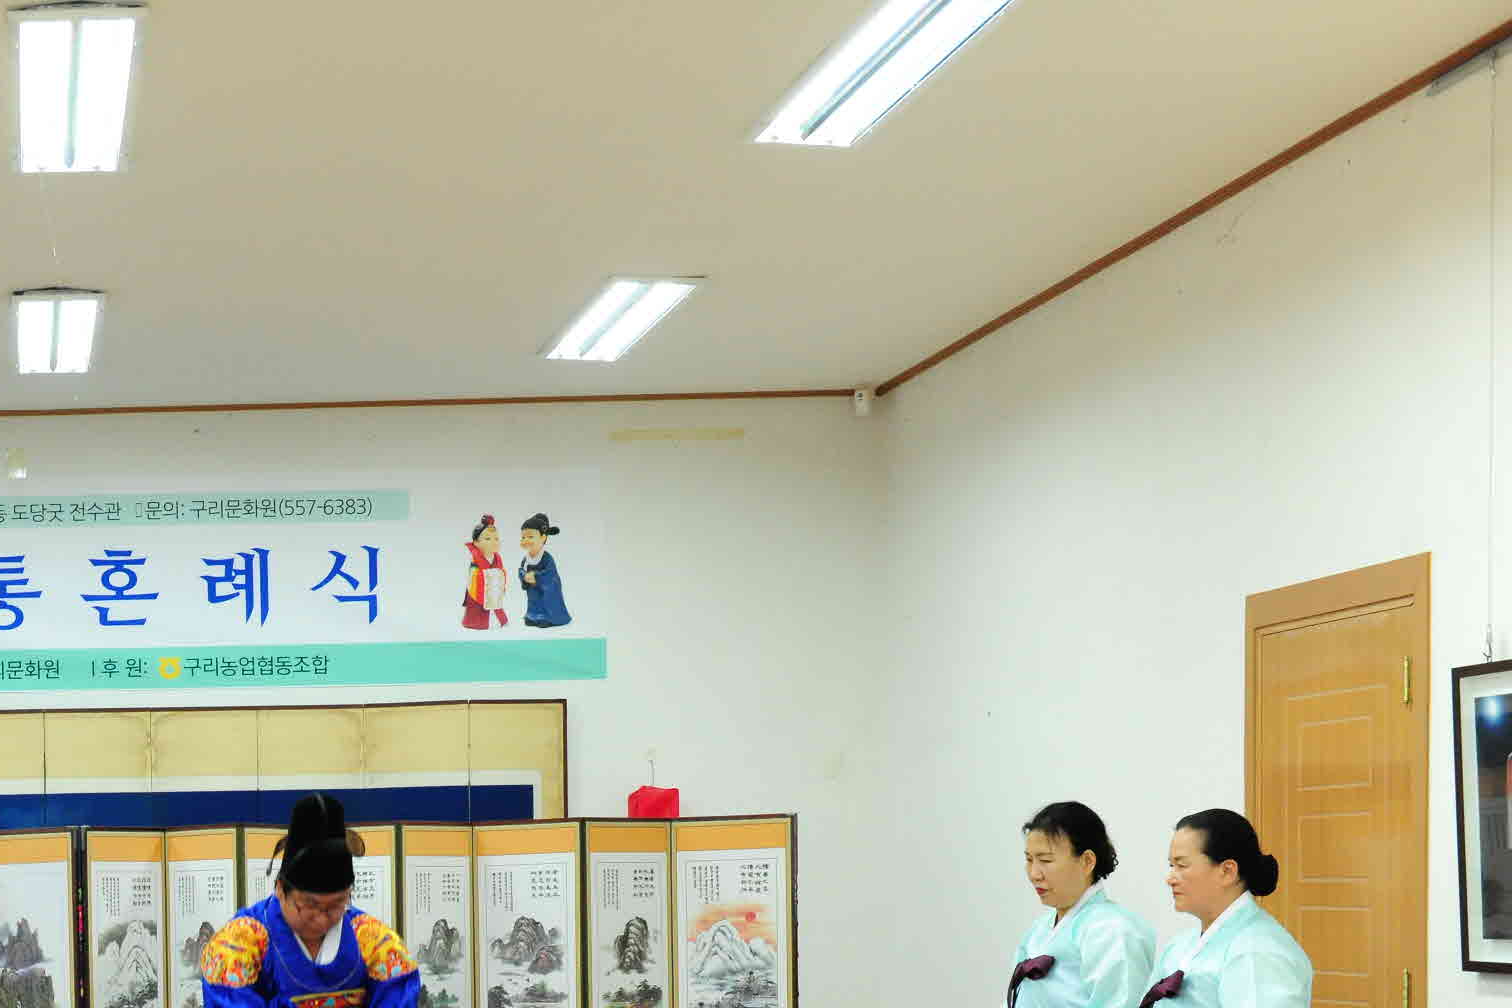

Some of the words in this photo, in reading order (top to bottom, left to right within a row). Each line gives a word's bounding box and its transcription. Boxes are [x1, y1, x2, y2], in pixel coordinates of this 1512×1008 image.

[12, 503, 65, 523] 도당굿
[69, 501, 121, 522] 전수관
[145, 500, 185, 520] 문의:
[183, 655, 330, 678] 구리농업협동조합
